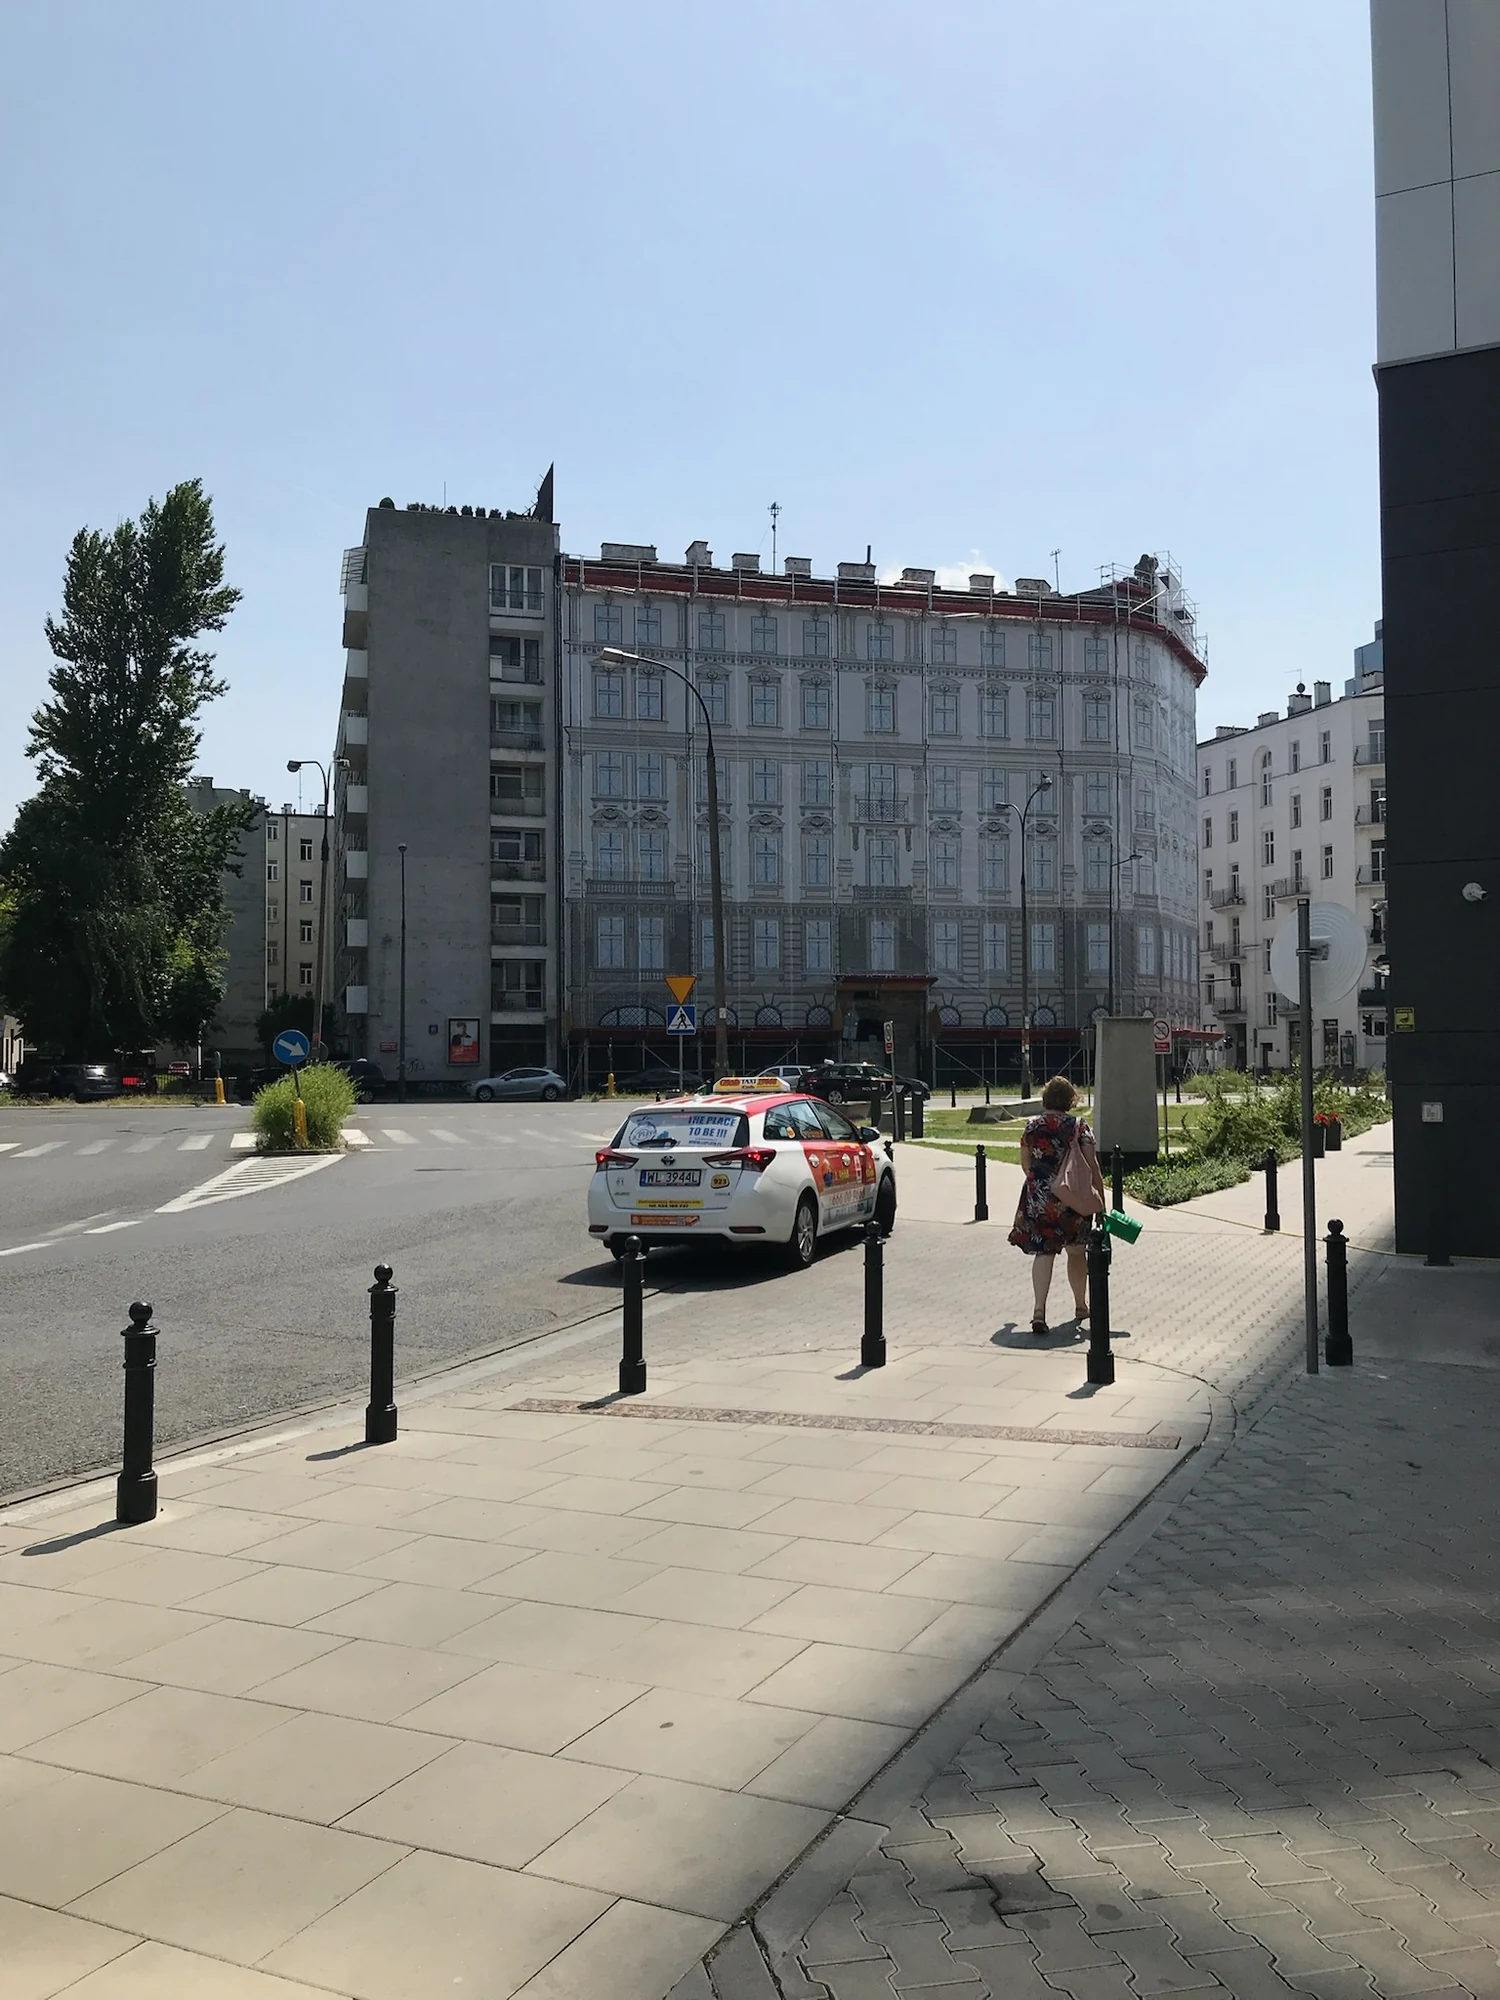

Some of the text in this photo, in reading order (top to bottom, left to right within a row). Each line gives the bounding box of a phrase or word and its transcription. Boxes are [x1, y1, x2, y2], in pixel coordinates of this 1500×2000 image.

[688, 1115, 736, 1127] THE PLACE
[689, 1127, 728, 1138] TO BE !!!
[647, 1172, 698, 1183] WL 3944L
